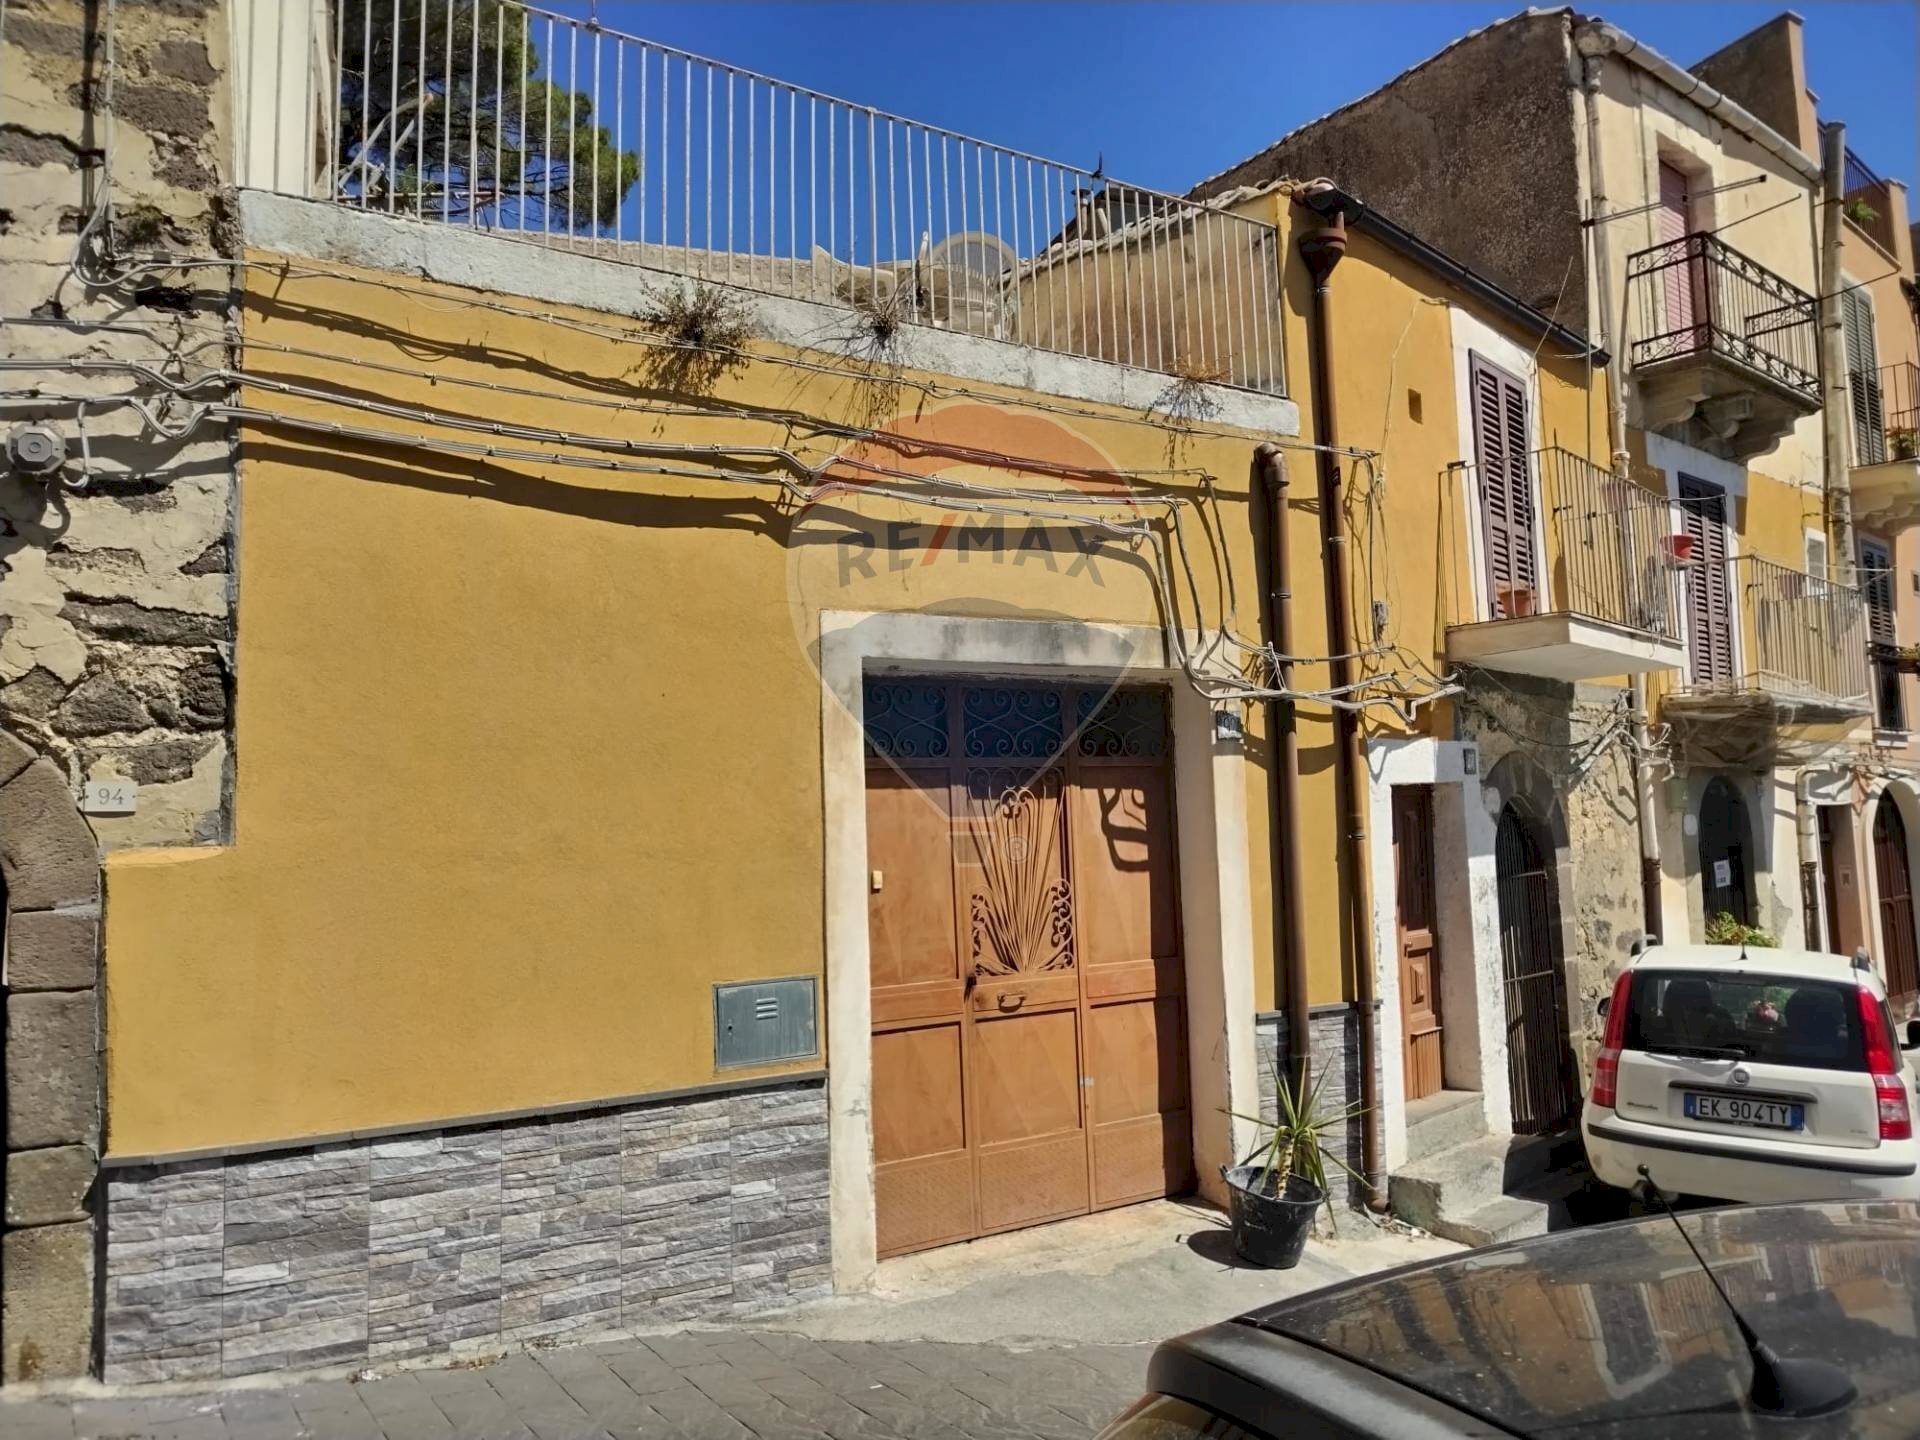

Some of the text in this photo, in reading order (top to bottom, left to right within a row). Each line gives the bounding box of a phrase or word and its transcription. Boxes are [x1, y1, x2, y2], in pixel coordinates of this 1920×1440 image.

[98, 787, 123, 805] 94
[1699, 1097, 1788, 1124] EK 904TY
